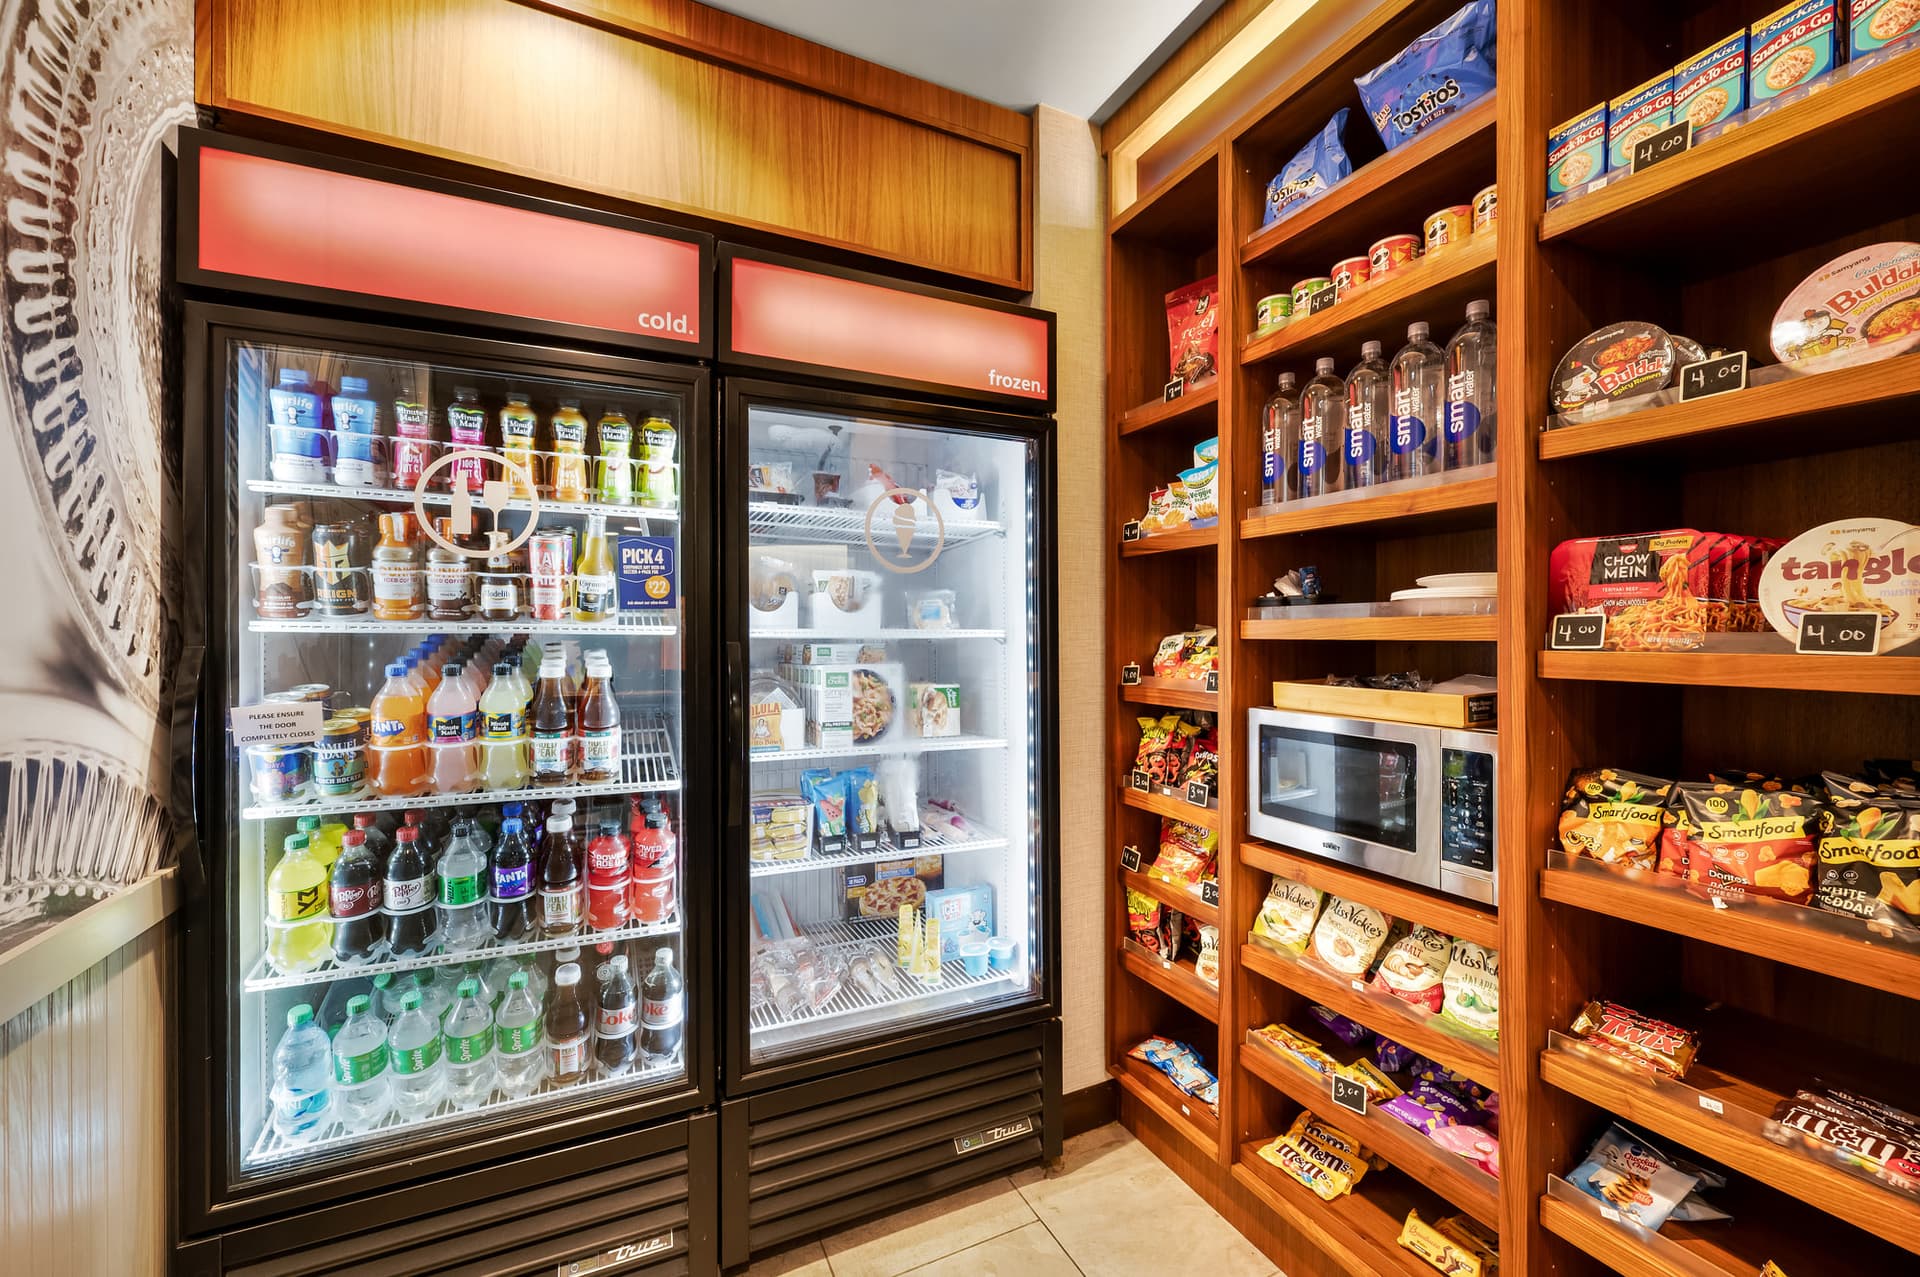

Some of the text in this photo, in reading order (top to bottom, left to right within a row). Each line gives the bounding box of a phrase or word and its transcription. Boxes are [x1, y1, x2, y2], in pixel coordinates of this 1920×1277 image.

[1639, 135, 1683, 162] 4.00
[638, 311, 694, 335] cold.
[988, 369, 1045, 394] frozen.
[1597, 357, 1665, 395] Buldak
[1692, 363, 1741, 389] 4.00
[1449, 371, 1465, 434] smart
[1397, 387, 1411, 447] smart
[1350, 402, 1364, 458] smart
[1264, 428, 1275, 477] smart
[1303, 415, 1315, 469] smart
[622, 548, 665, 565] PICK 4
[1603, 553, 1650, 567] CHOW
[1604, 565, 1647, 580] MEIN
[648, 580, 668, 595] $22
[1559, 624, 1597, 642] 4.00
[1807, 624, 1866, 645] 4.00
[248, 710, 305, 721] PLEASE ENSURE
[258, 721, 297, 731] THE DOOR
[372, 719, 404, 733] FANTA
[240, 730, 316, 743] COMPLETELY CLOSES
[1587, 783, 1601, 792] 100
[1593, 805, 1658, 822] Smartfood
[1708, 799, 1726, 809] 100
[1708, 821, 1796, 840] Smartfood
[1820, 841, 1920, 862] Smartfood
[495, 870, 527, 883] FANTA
[1451, 946, 1481, 969] Miss
[460, 1038, 471, 1062] Sprite
[511, 1028, 521, 1052] Sprite
[412, 1048, 424, 1072] Sprite
